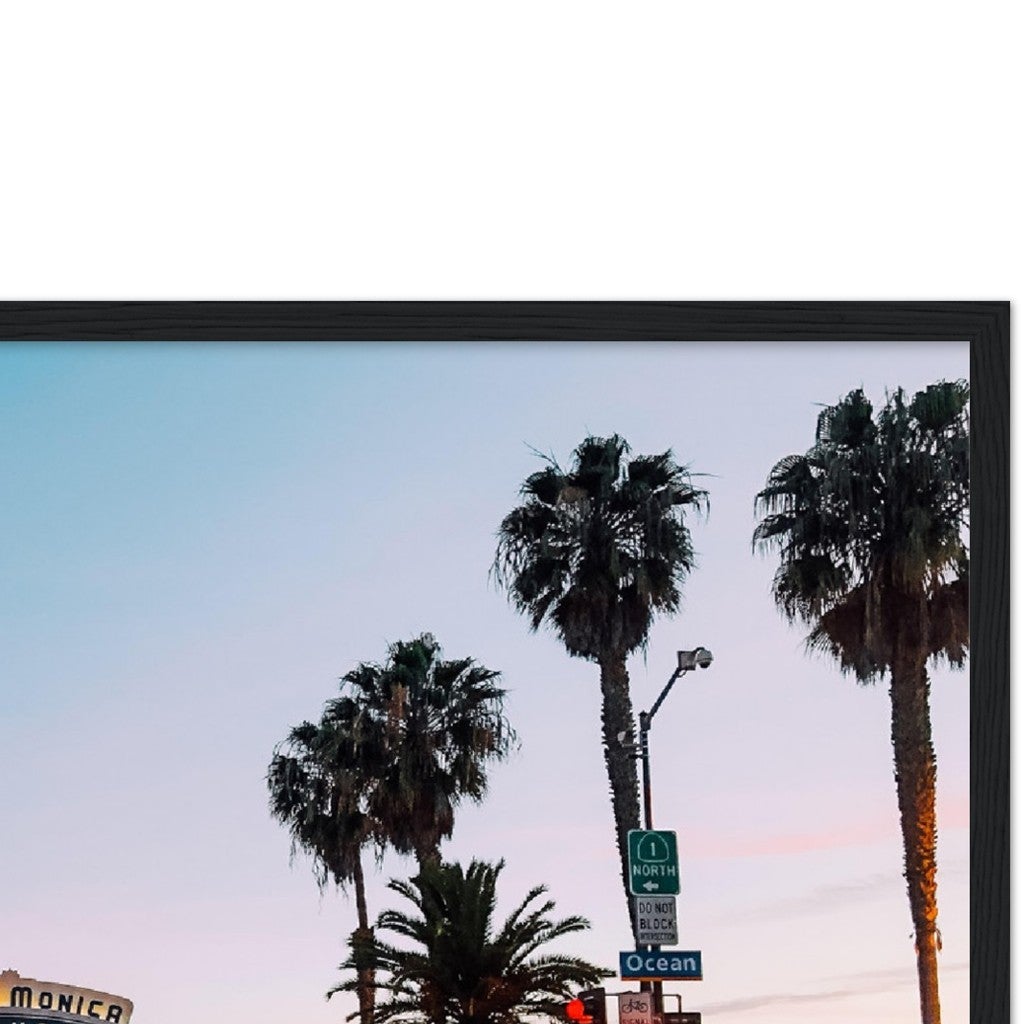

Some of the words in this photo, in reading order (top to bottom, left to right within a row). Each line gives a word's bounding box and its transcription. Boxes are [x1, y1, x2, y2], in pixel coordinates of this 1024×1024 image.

[650, 842, 656, 857] 1
[633, 864, 676, 877] NORTH
[639, 902, 653, 914] DO
[654, 902, 674, 914] NOT
[640, 918, 675, 930] BLOCK
[626, 954, 697, 972] Ocean
[10, 986, 123, 1023] MONICA
